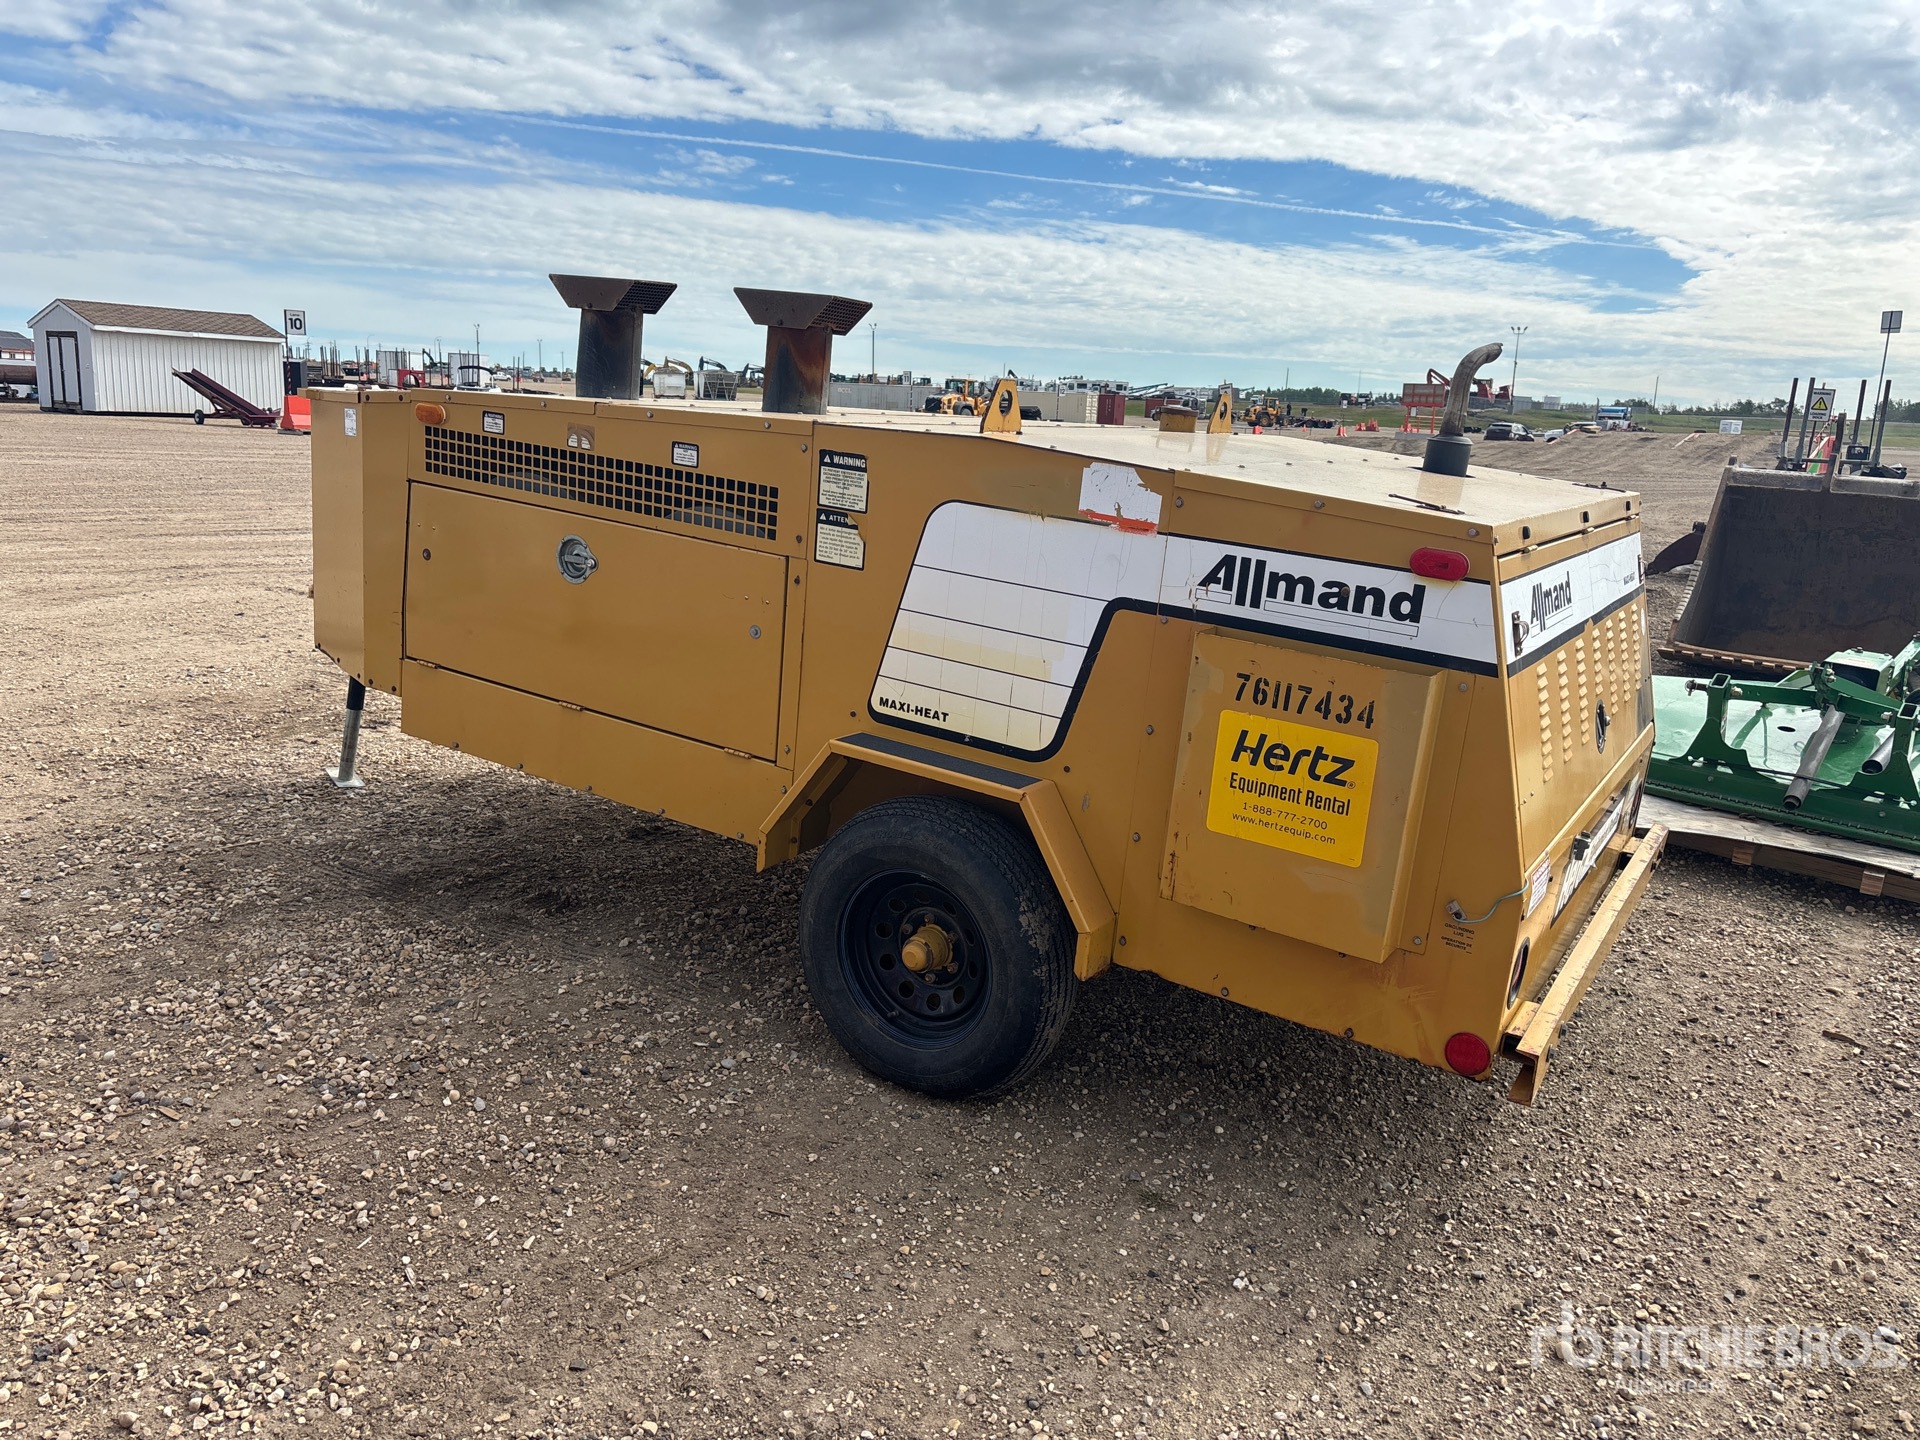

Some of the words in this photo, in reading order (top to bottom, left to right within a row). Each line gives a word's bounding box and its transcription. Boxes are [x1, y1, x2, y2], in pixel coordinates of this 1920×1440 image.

[288, 317, 303, 331] 10
[832, 454, 866, 468] WARNING
[828, 514, 848, 523] ATTEN
[1197, 553, 1427, 624] Allmand
[1530, 570, 1572, 633] Allmand
[878, 696, 950, 722] MAXI-HEAT
[1235, 672, 1375, 730] 76117434
[1230, 729, 1356, 788] Hertz
[1229, 772, 1303, 805] Equipment
[1304, 789, 1351, 816] Rental
[1231, 812, 1336, 845] www.hertzequip.com
[1242, 801, 1328, 831] 1-888-777-2700
[1444, 922, 1474, 934] GROUNDING
